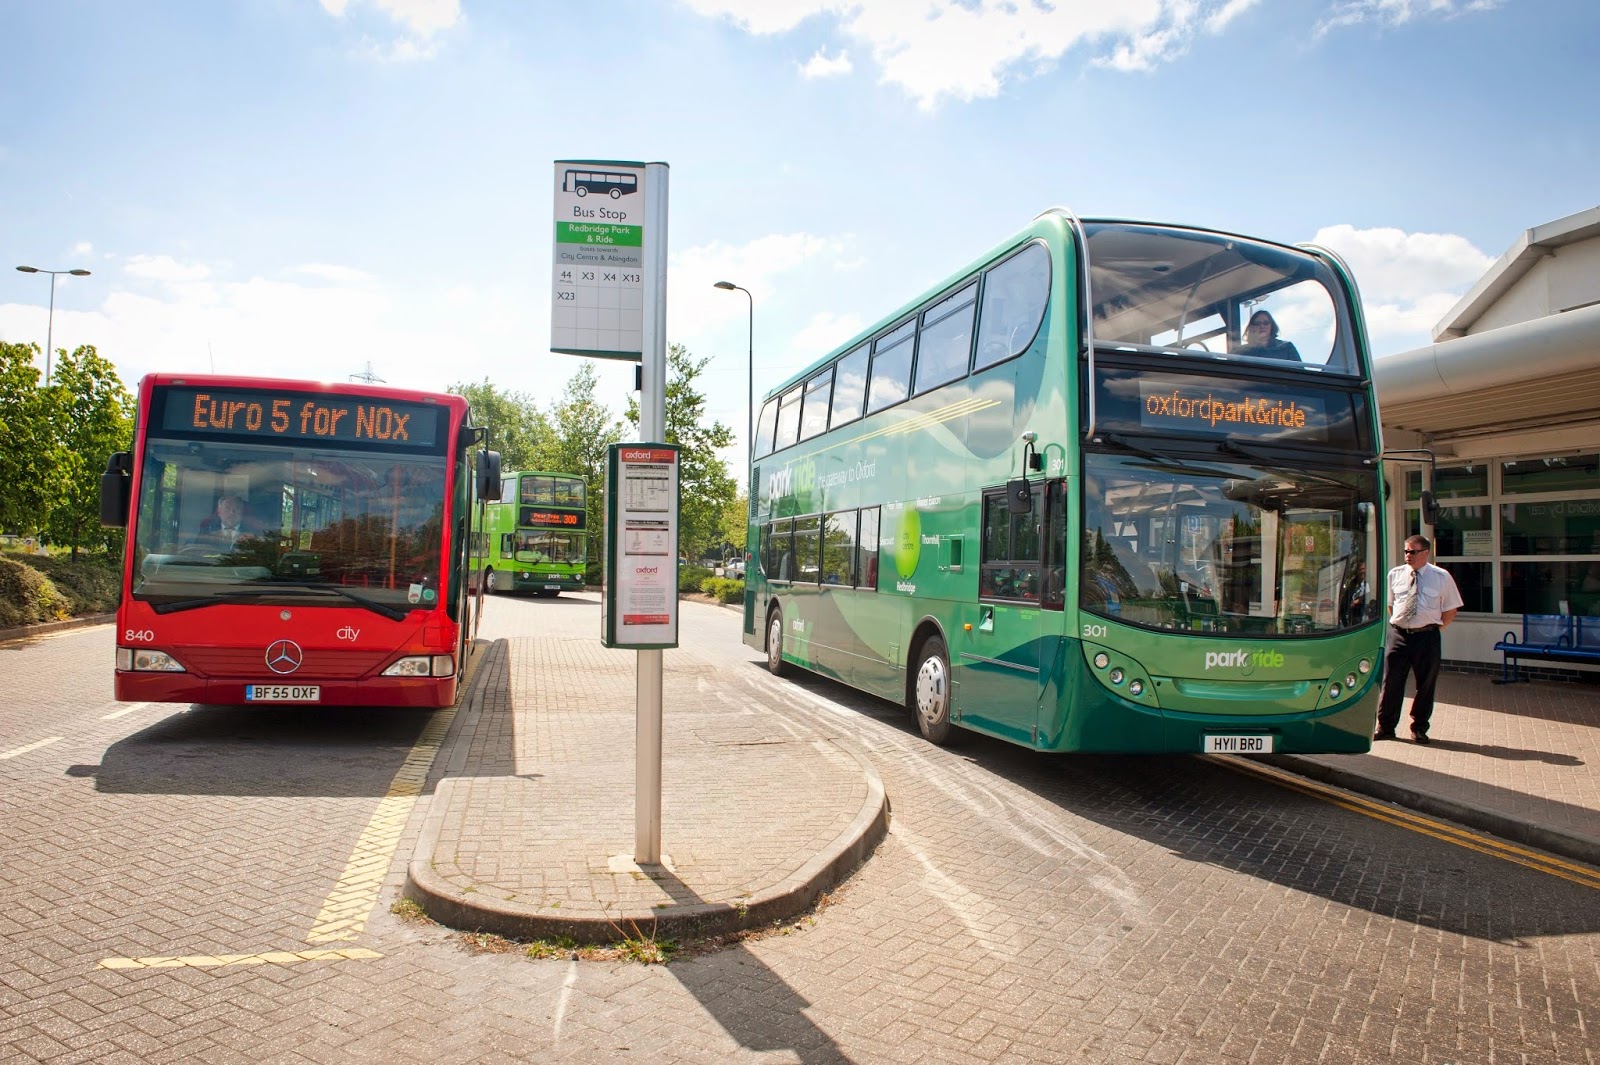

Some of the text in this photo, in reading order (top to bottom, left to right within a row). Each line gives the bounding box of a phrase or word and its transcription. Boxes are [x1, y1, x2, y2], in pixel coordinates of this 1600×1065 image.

[573, 206, 627, 222] Bus Stop
[569, 224, 630, 235] Redbridge Park
[587, 235, 614, 243] & Ride
[576, 253, 598, 261] Centre
[607, 255, 638, 264] Abingdon
[561, 271, 640, 283] 44 X3 X4 X13
[557, 291, 575, 301] X23
[193, 394, 410, 440] Euro 5 for NOx
[625, 451, 651, 459] oxford
[1052, 458, 1064, 471] 301
[825, 470, 848, 492] gateway
[848, 467, 855, 482] to
[856, 458, 876, 480] Oxford
[564, 515, 577, 524] 300
[922, 534, 940, 545] Thornhill
[636, 566, 657, 574] oxford
[897, 581, 916, 595] Redbridge
[125, 629, 155, 642] 840
[336, 625, 361, 643] city
[1083, 625, 1107, 638] 301
[254, 686, 318, 700] BF55 OXF
[1240, 738, 1263, 750] BRD
